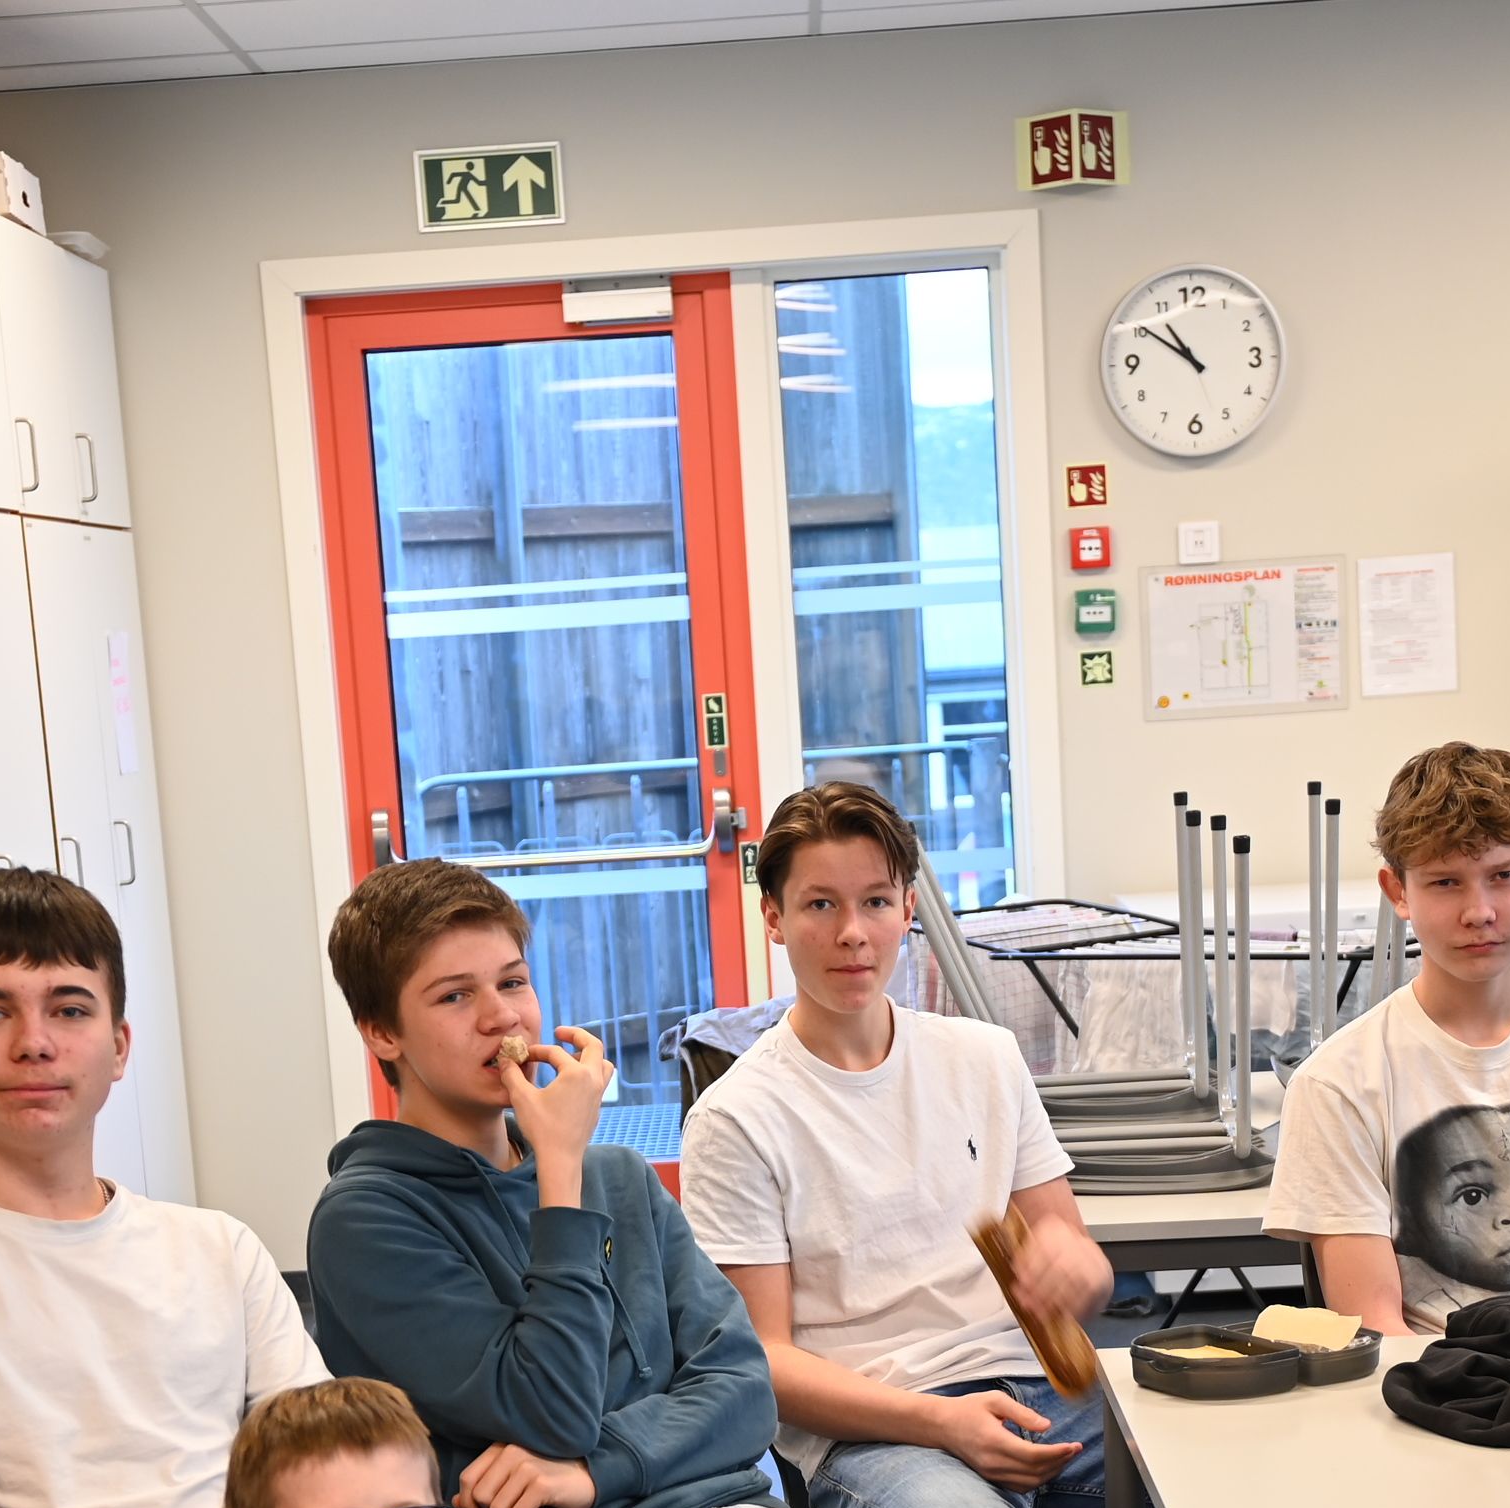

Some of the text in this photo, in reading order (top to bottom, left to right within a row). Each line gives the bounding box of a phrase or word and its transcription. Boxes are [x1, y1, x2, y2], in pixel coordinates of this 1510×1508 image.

[1178, 286, 1206, 307] 12
[1155, 301, 1169, 313] 11
[1242, 320, 1251, 332] 2
[1248, 346, 1262, 368] 3
[1125, 354, 1140, 375] 9
[1137, 390, 1146, 401] 8
[1243, 384, 1252, 396] 4
[1160, 411, 1168, 423] 7
[1222, 408, 1230, 420] 5
[1187, 413, 1203, 434] 6
[1164, 569, 1282, 586] RØMNINGSPLAN
